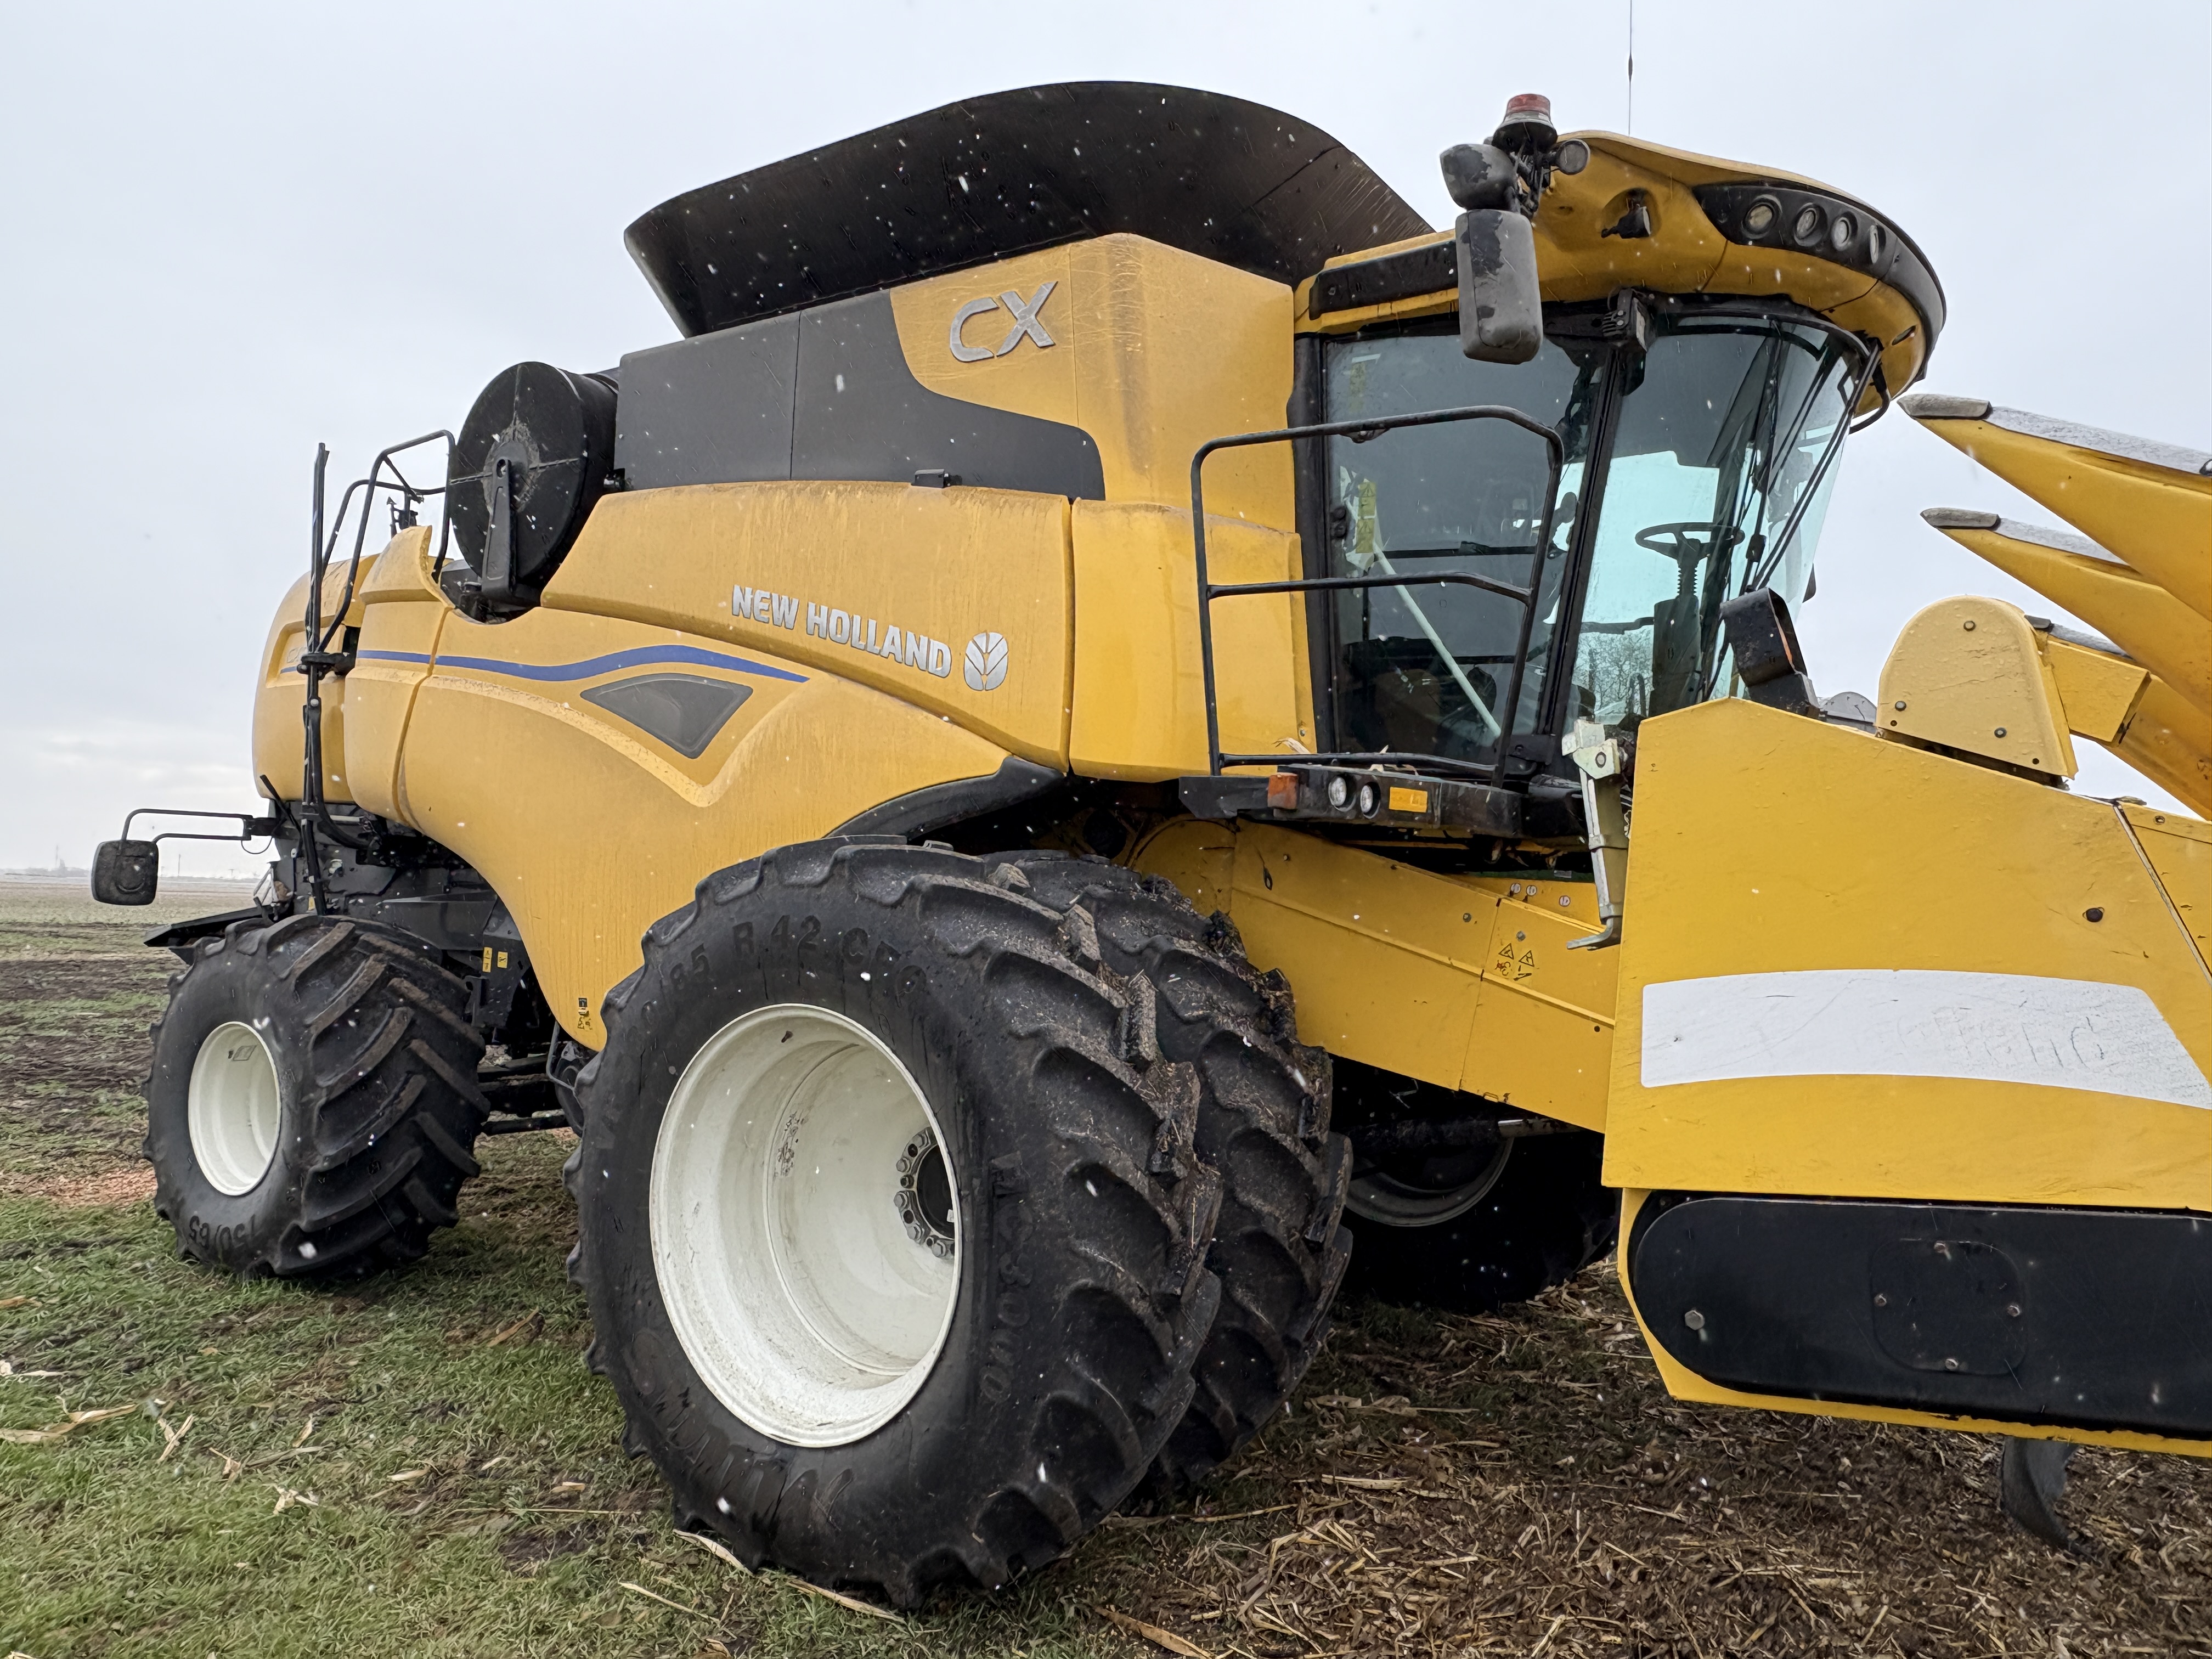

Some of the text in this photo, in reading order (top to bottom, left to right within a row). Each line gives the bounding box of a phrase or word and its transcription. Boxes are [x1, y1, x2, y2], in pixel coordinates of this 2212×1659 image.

[950, 281, 1058, 363] CX
[732, 585, 952, 679] NEW HOLLAND
[770, 914, 822, 952] 42
